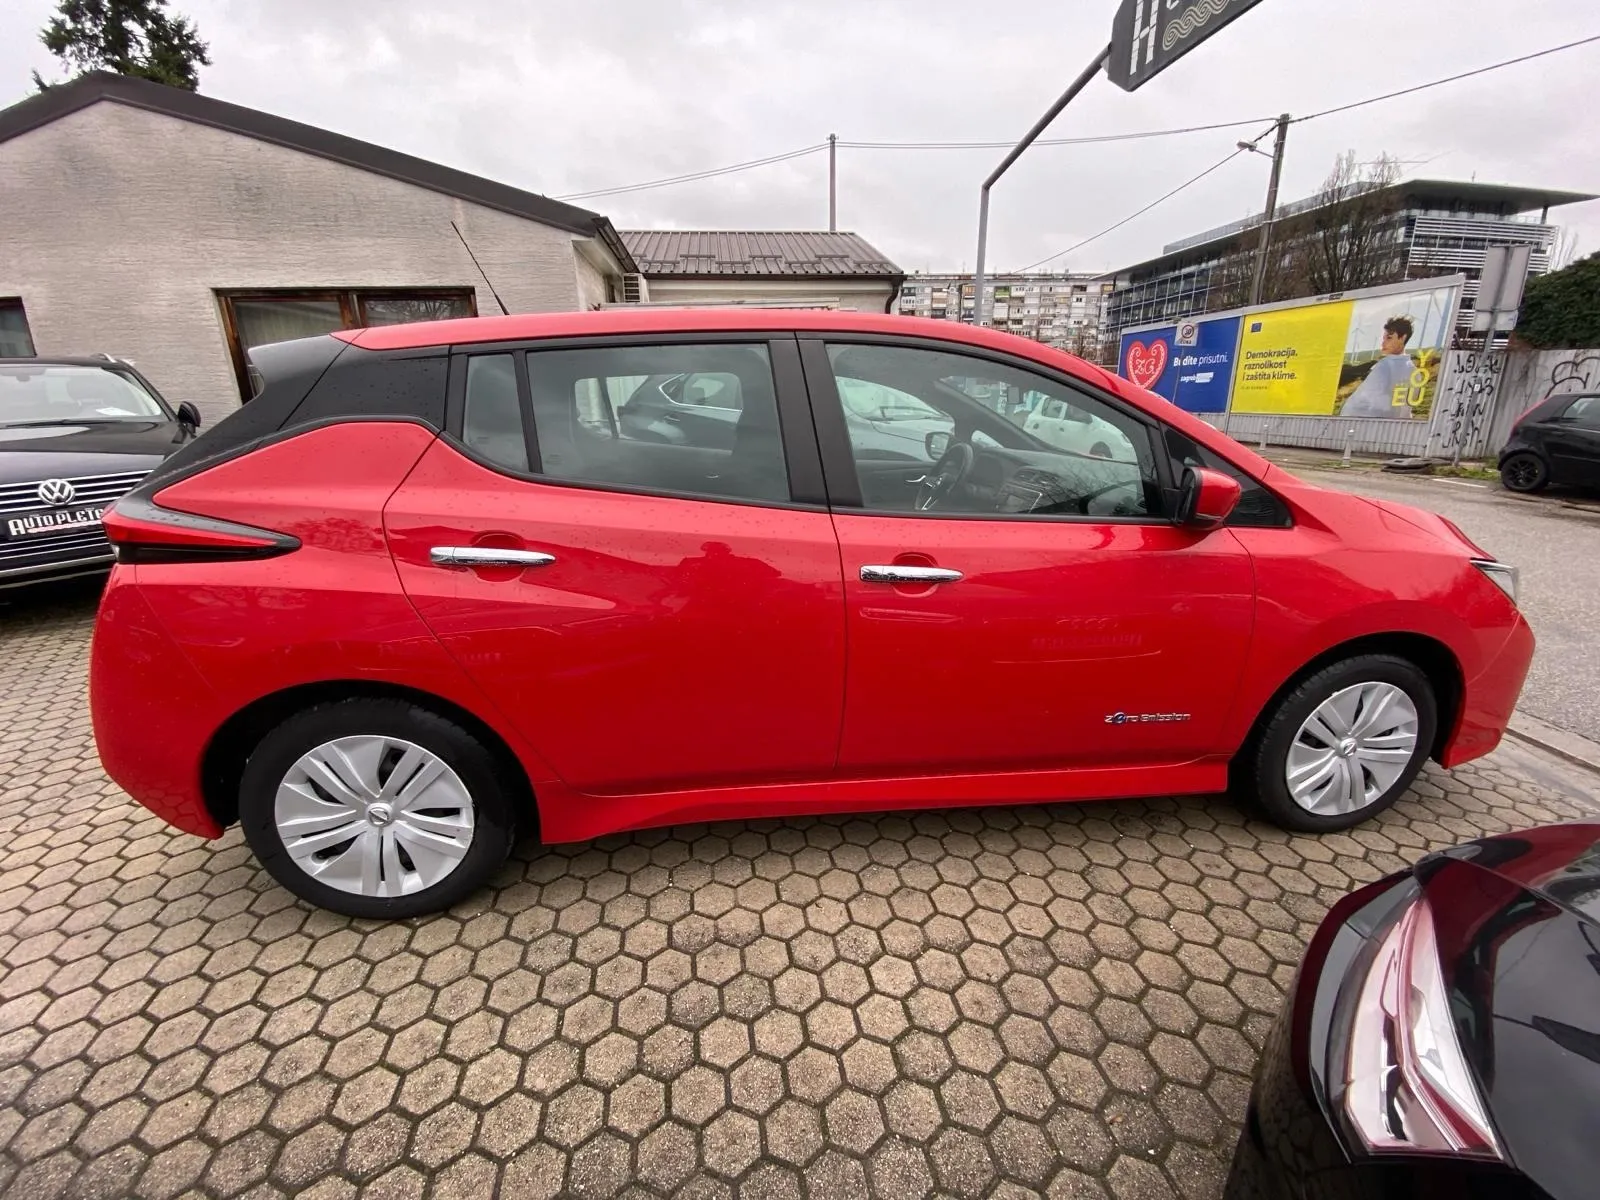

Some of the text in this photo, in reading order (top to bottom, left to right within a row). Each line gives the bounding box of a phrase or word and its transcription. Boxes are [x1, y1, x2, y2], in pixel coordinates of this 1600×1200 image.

[1246, 348, 1298, 360] Demokracija,
[1244, 360, 1287, 371] raznolikost
[1246, 371, 1271, 381] zaštita
[1272, 370, 1297, 380] klime.
[8, 514, 54, 536] AUTO
